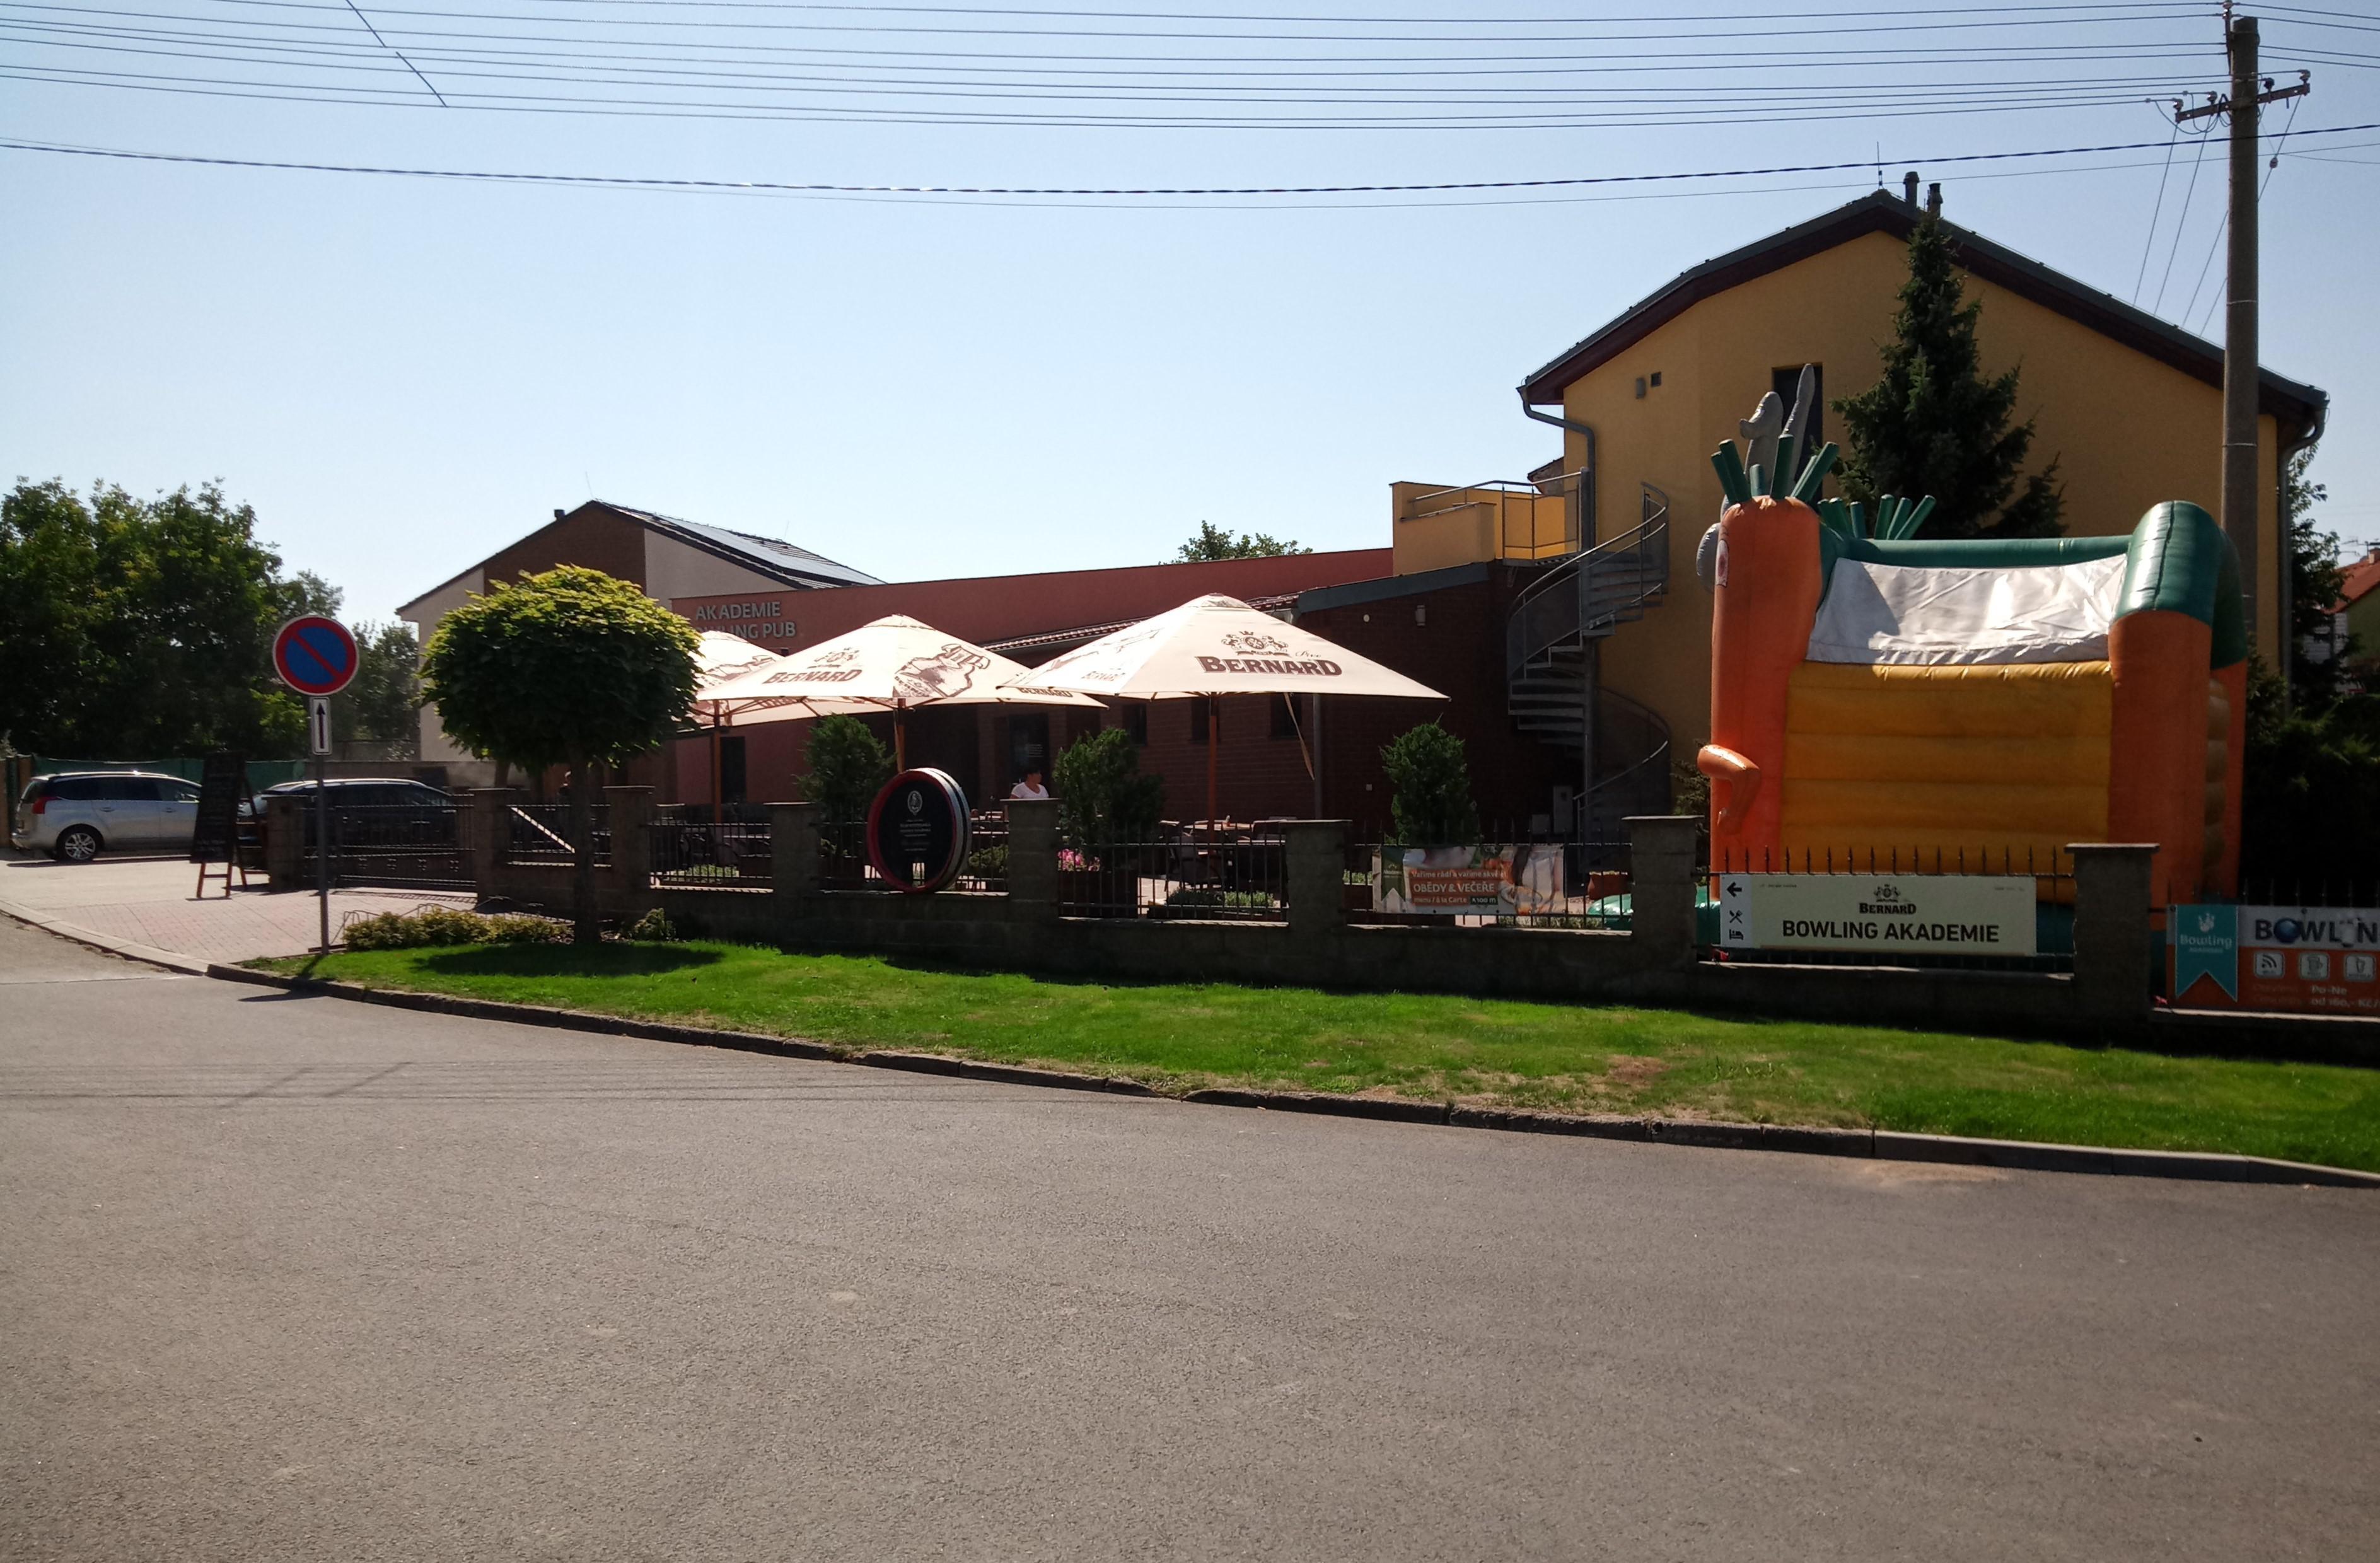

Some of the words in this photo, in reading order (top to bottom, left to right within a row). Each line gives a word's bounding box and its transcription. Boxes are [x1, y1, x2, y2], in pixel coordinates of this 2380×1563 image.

[695, 601, 781, 620] AKADEMIE
[762, 622, 796, 638] PUB
[1195, 656, 1342, 677] BERNARD
[762, 669, 862, 685] BERNARD
[1413, 881, 1447, 892] OBĚDY
[1448, 883, 1456, 892] &
[1457, 881, 1494, 892] VEČEŘE
[1859, 902, 1917, 915] BERNARD
[1782, 920, 1878, 939] BOWLING
[1884, 924, 1999, 943] AKADEMIE
[2180, 934, 2232, 950] Bowling
